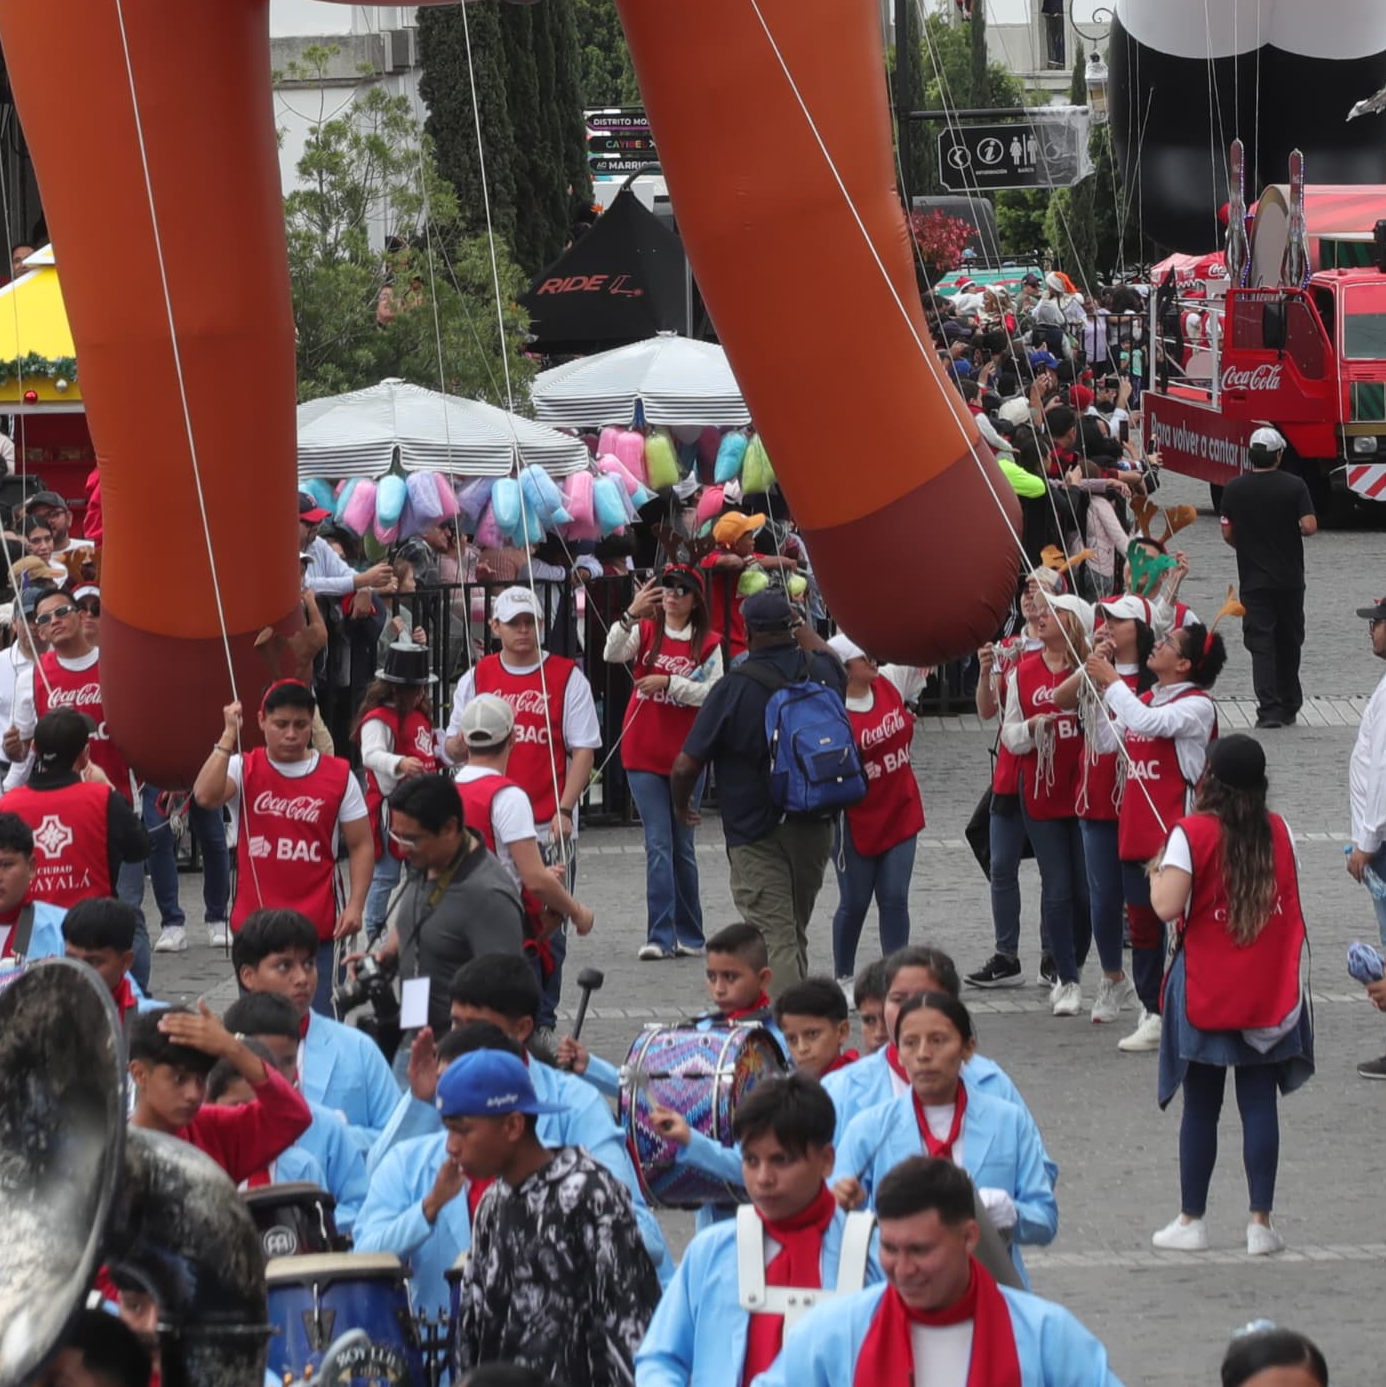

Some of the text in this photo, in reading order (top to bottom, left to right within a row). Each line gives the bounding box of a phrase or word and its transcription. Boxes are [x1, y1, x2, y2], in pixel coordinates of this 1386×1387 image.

[593, 118, 649, 126] DISTRITO MO
[537, 274, 610, 295] RIDE
[1221, 364, 1283, 391] Coca-Cola
[1150, 412, 1171, 447] Para
[1172, 419, 1200, 456] volver
[1200, 437, 1208, 457] a
[1208, 436, 1239, 465] cantar
[514, 724, 551, 745] BAC
[861, 705, 906, 751] Coca-Cola
[1127, 760, 1161, 780] BAC
[254, 790, 326, 823] Coca-Cola
[276, 837, 322, 863] BAC
[29, 867, 91, 893] AYALÁ
